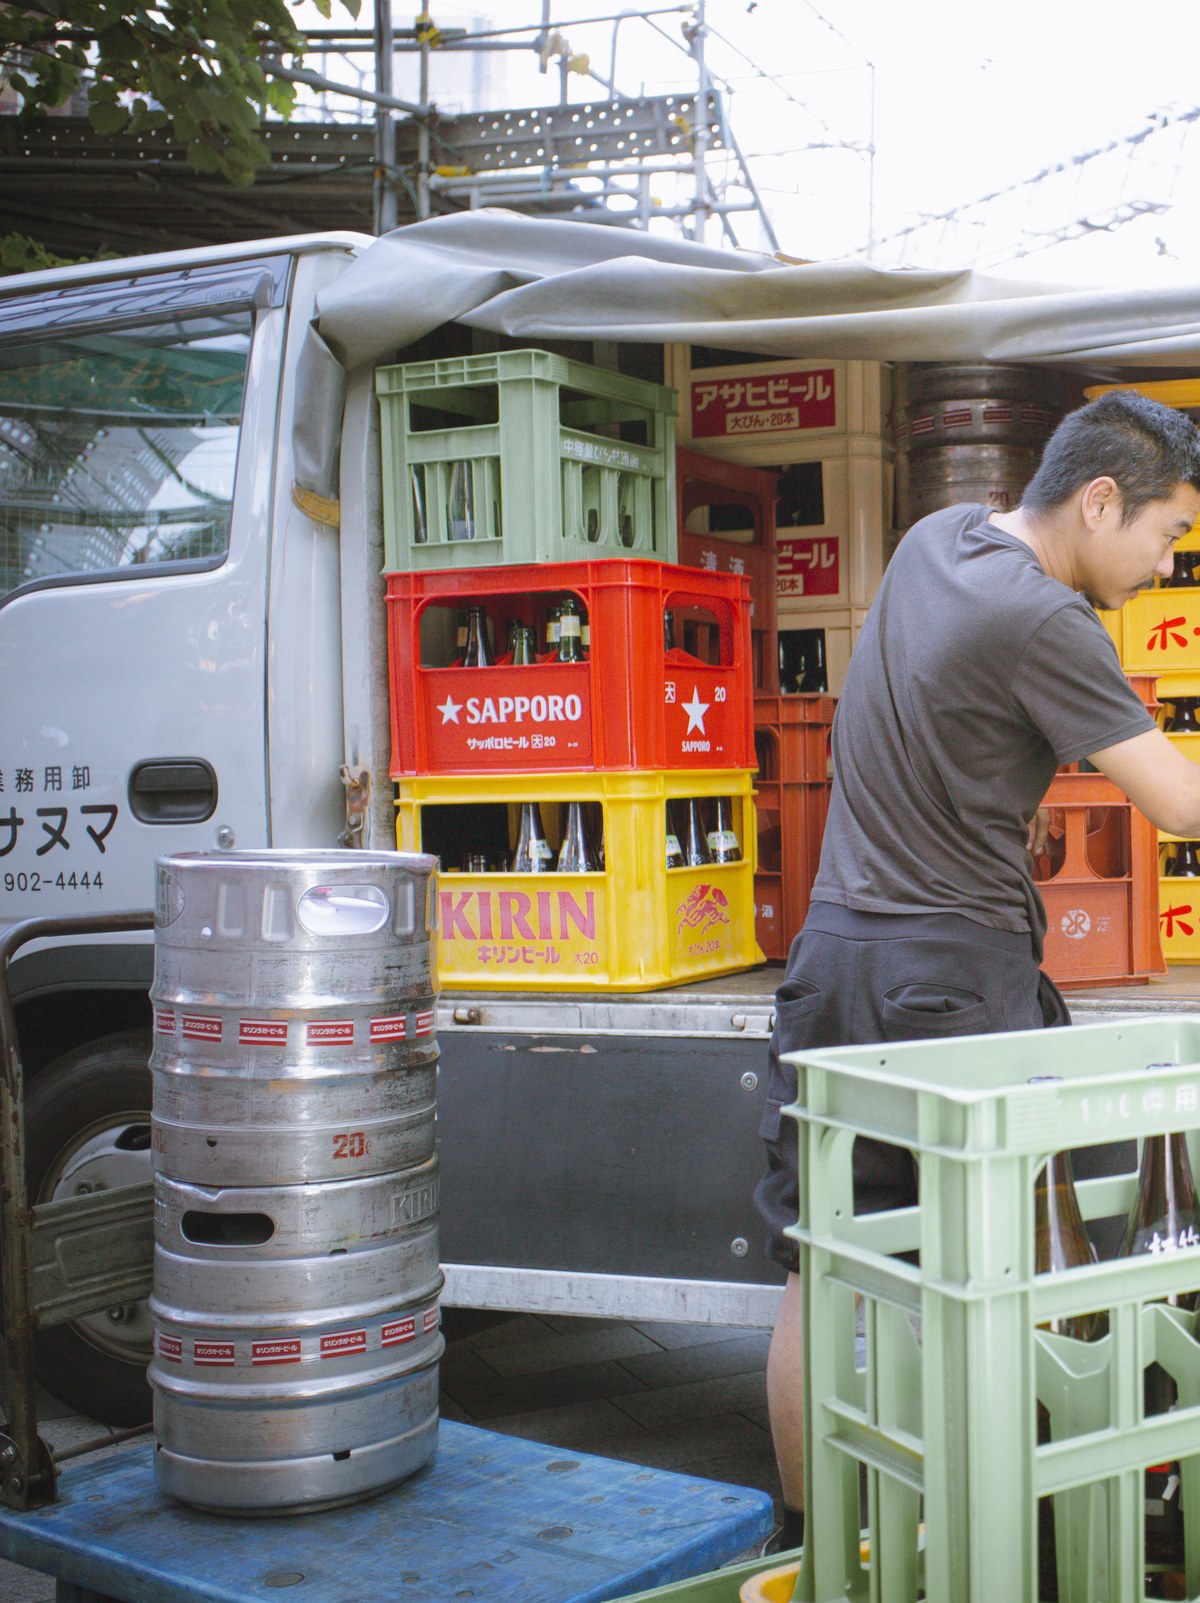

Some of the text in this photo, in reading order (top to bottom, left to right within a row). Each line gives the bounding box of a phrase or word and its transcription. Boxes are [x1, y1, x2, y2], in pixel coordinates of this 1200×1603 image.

[695, 375, 831, 412] アサヒビール
[776, 543, 835, 571] ビール
[714, 687, 726, 702] 20
[466, 693, 582, 725] SAPPORO
[467, 736, 529, 750] サッポロビール
[681, 740, 711, 752] SAPPORO
[0, 765, 91, 792] 務用卸
[4, 871, 103, 891] 902-4444
[438, 891, 597, 940] KIRIN
[477, 946, 599, 964] キリンビール 大20
